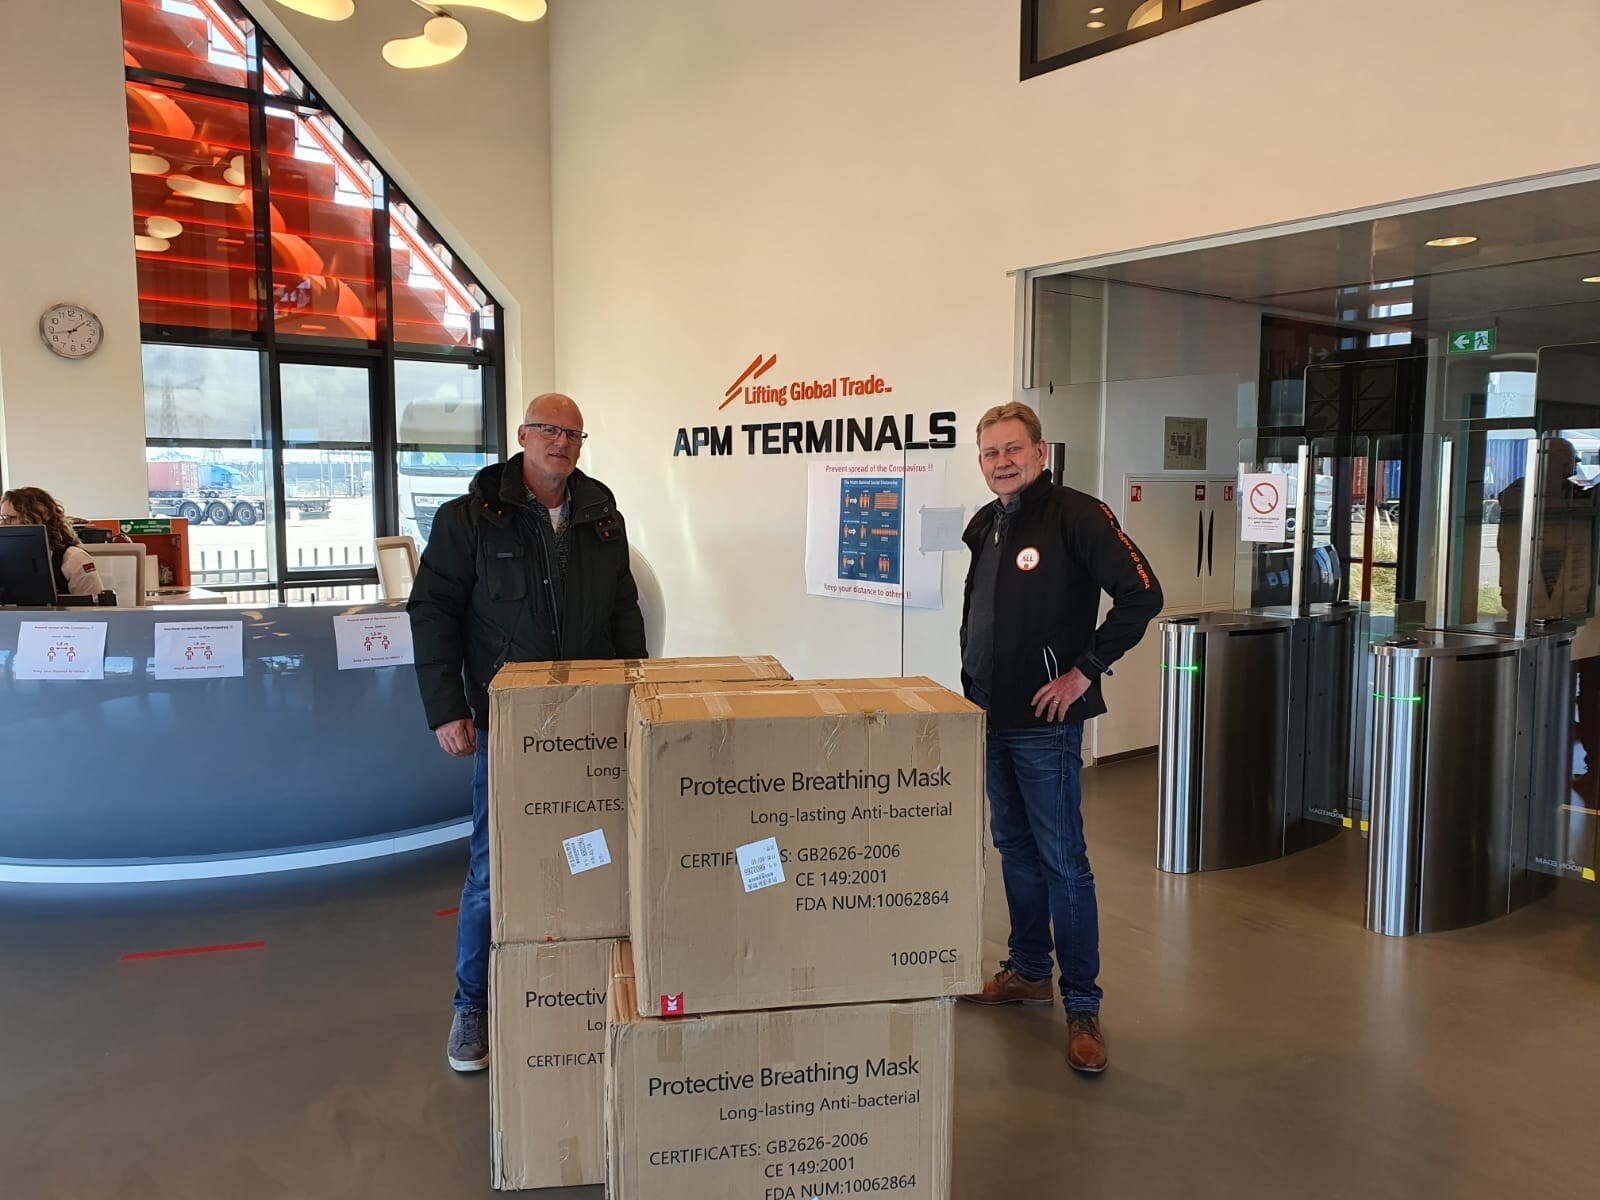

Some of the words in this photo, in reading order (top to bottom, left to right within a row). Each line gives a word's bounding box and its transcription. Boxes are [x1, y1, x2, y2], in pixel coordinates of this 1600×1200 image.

[744, 385, 787, 406] Lifting
[790, 379, 836, 401] Global
[840, 375, 885, 396] Trade
[672, 425, 733, 456] APM
[742, 411, 956, 455] TERMINALS
[849, 464, 868, 473] spread
[870, 464, 876, 472] of
[877, 464, 887, 472] the
[888, 464, 926, 472] Coronavirus
[1131, 552, 1140, 562] GO
[853, 585, 876, 595] distance
[523, 733, 617, 753] Protective
[680, 773, 786, 796] Protective
[792, 769, 890, 794] Breathing
[897, 766, 952, 787] Mask
[524, 799, 624, 815] CERTIFICATES:
[751, 806, 846, 826] Long-lasting
[851, 802, 952, 820] Anti-bacterial
[798, 844, 901, 862] GB2626-2006
[796, 872, 814, 886] CE
[820, 869, 887, 885] 149:2001
[796, 896, 827, 911] FDA
[833, 890, 949, 910] NUM:10062864
[891, 949, 957, 966] 1000PCS
[649, 1071, 754, 1096] Protective
[760, 1062, 858, 1087] Breathing
[866, 1056, 920, 1078] Mask
[720, 1100, 814, 1122] Long-lasting
[820, 1090, 920, 1111] Anti-bacterial
[650, 1143, 761, 1166] CERTIFICATES:
[766, 1132, 868, 1154] GB2626-2006
[764, 1164, 783, 1178] CE
[789, 1156, 855, 1176] 149:2001
[765, 1186, 795, 1200] FDA
[801, 1175, 916, 1198] NUM:10062864
